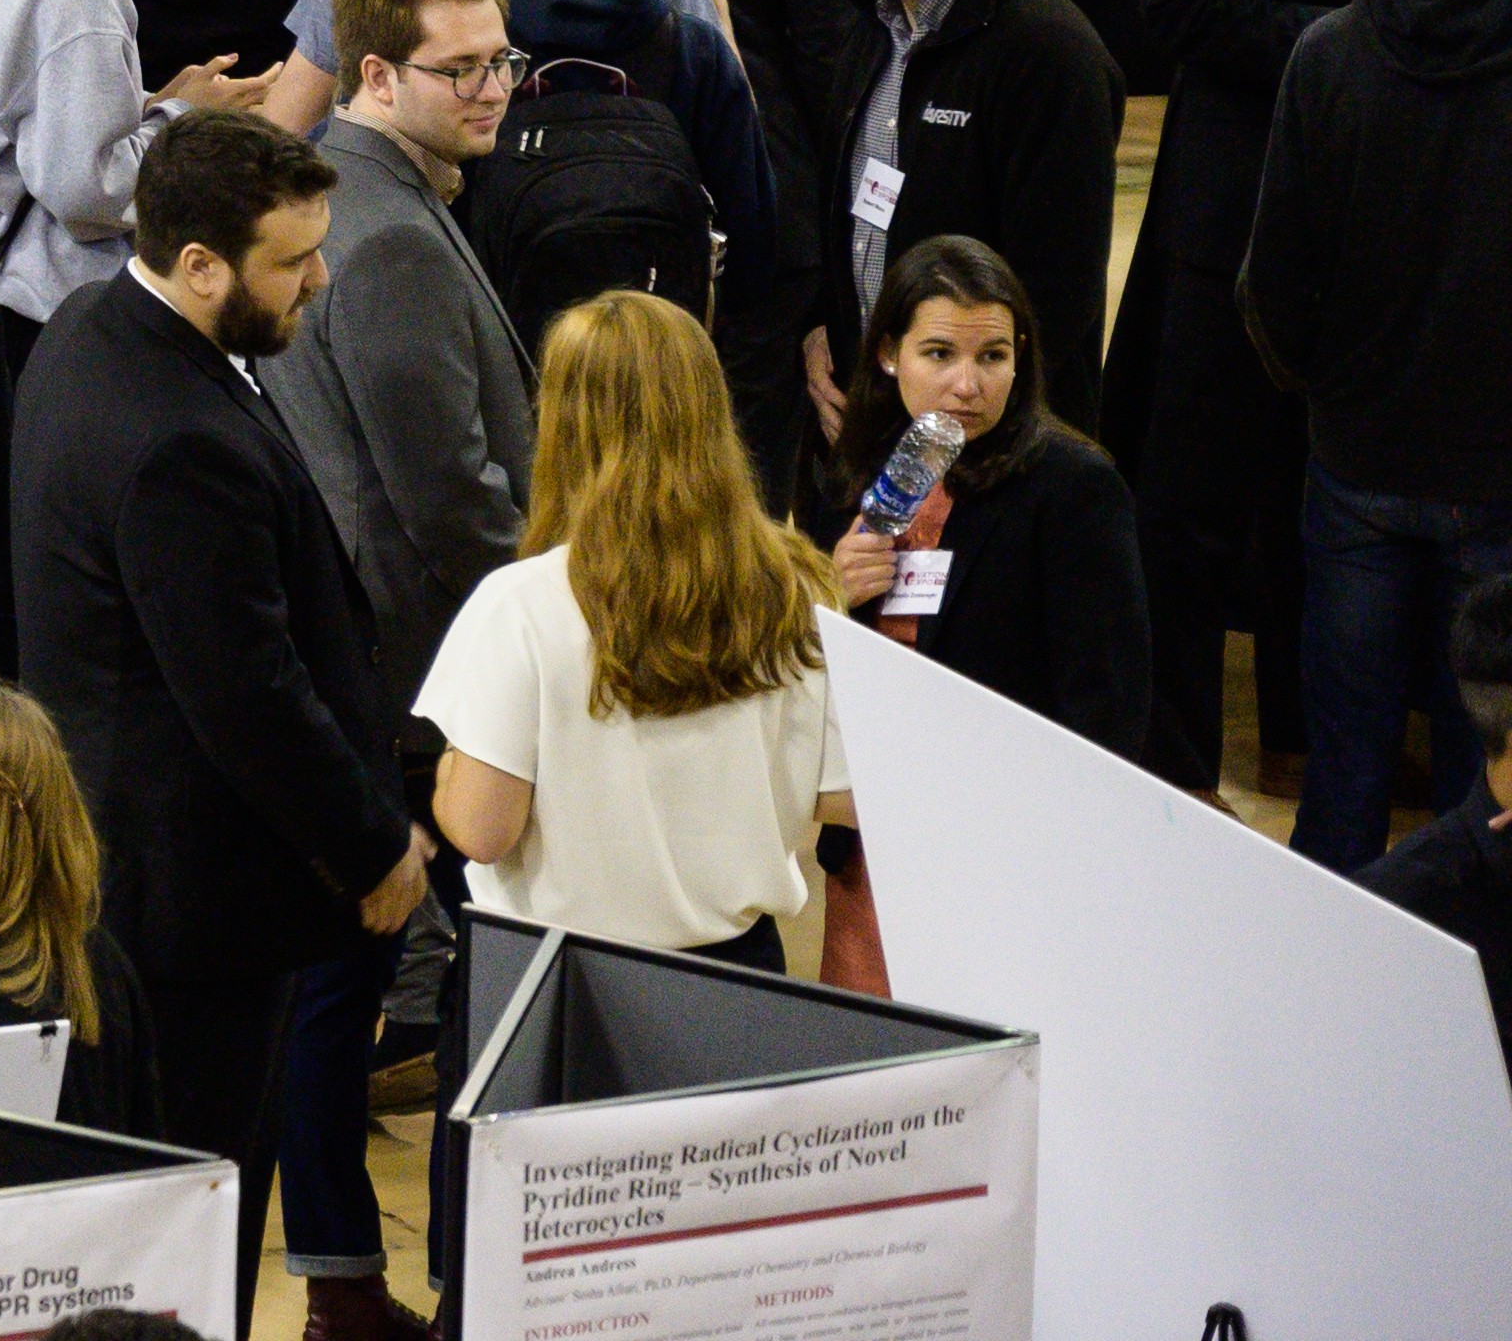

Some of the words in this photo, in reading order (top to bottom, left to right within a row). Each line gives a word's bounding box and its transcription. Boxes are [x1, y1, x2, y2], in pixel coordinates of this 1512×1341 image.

[523, 1149, 672, 1185] Investigating
[680, 1133, 765, 1167] Radical
[773, 1118, 894, 1158] Cyclization
[900, 1111, 925, 1132] on
[933, 1104, 965, 1130] the
[523, 1183, 621, 1216] Pyridine
[628, 1173, 682, 1202] Ring
[708, 1156, 812, 1193] Synthesis
[819, 1151, 841, 1174] of
[847, 1141, 907, 1169] Novel
[524, 1207, 665, 1243] Heterocycles
[23, 1266, 79, 1289] Drug
[39, 1283, 135, 1315] systems
